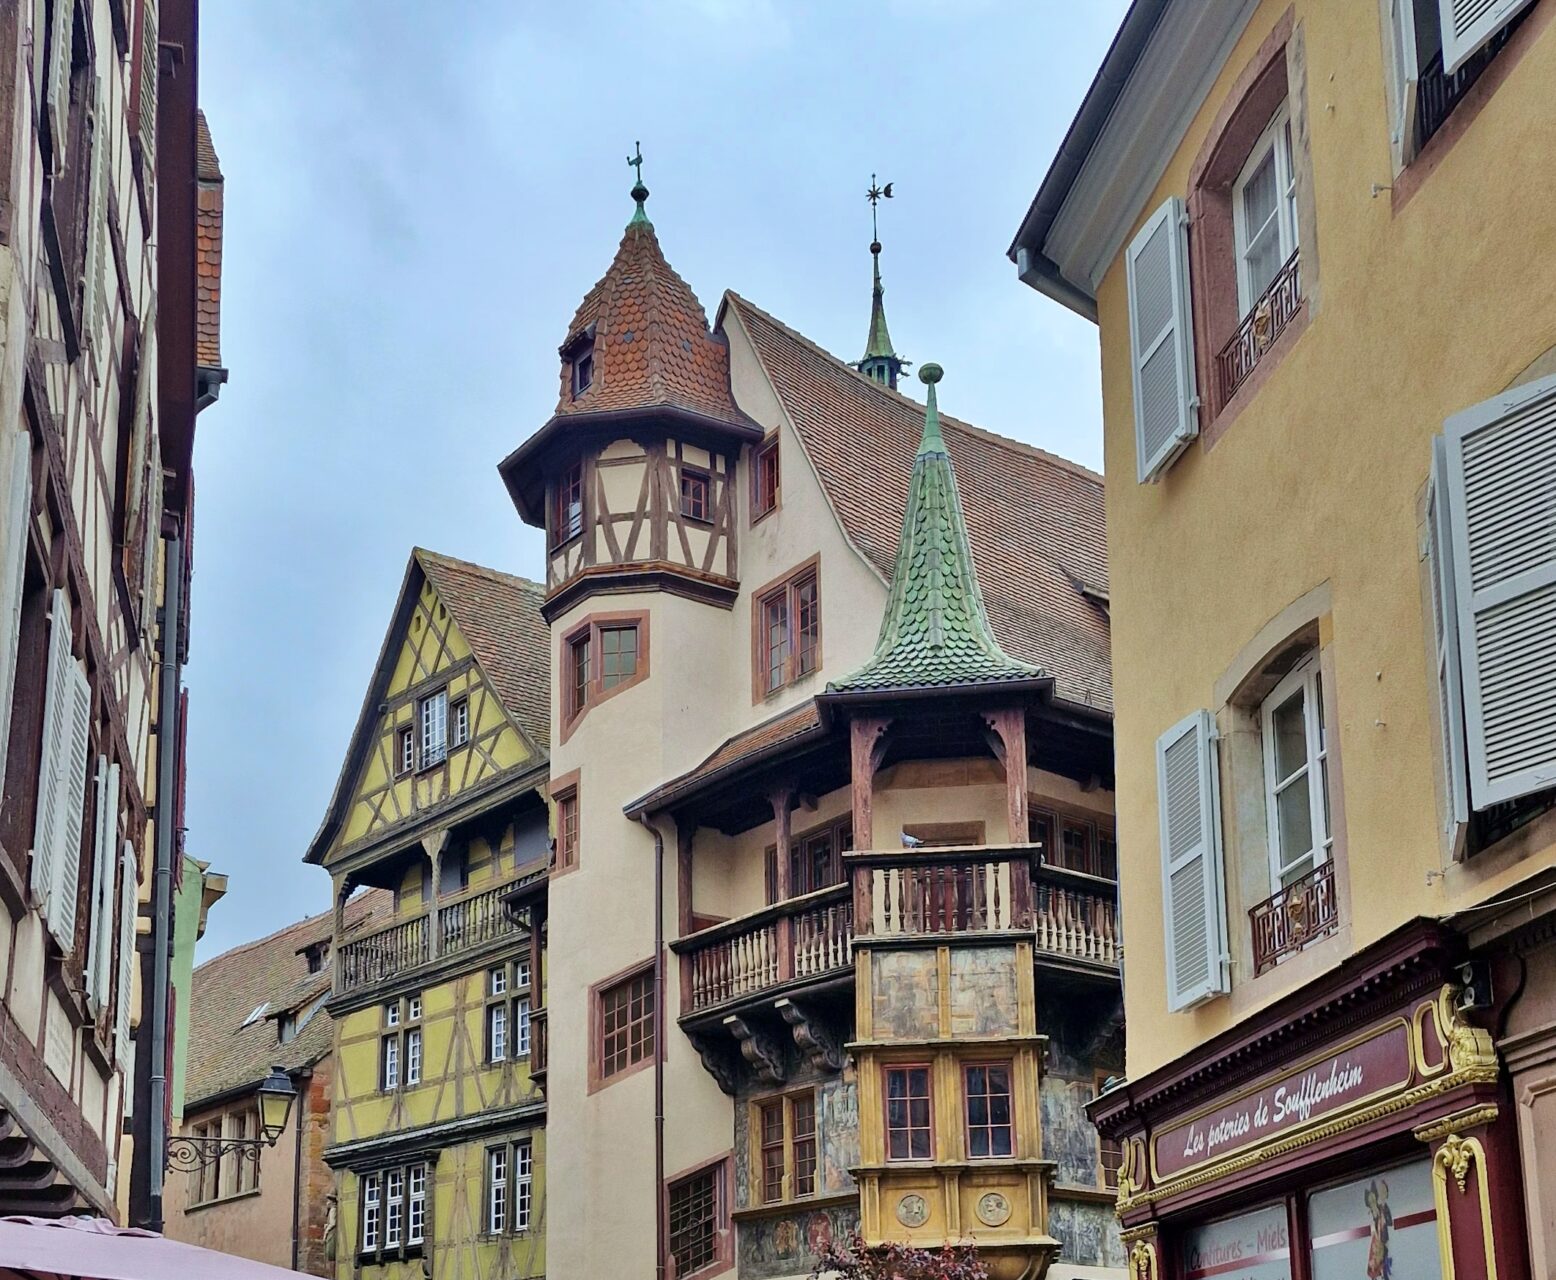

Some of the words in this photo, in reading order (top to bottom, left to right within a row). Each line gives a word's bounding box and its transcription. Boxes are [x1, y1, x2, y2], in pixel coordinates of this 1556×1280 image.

[1183, 1125, 1205, 1157] Les
[1207, 1111, 1250, 1156] poteries
[1254, 1097, 1269, 1128] de
[1273, 1059, 1363, 1122] Soufflenheim
[1257, 1224, 1286, 1254] Miels
